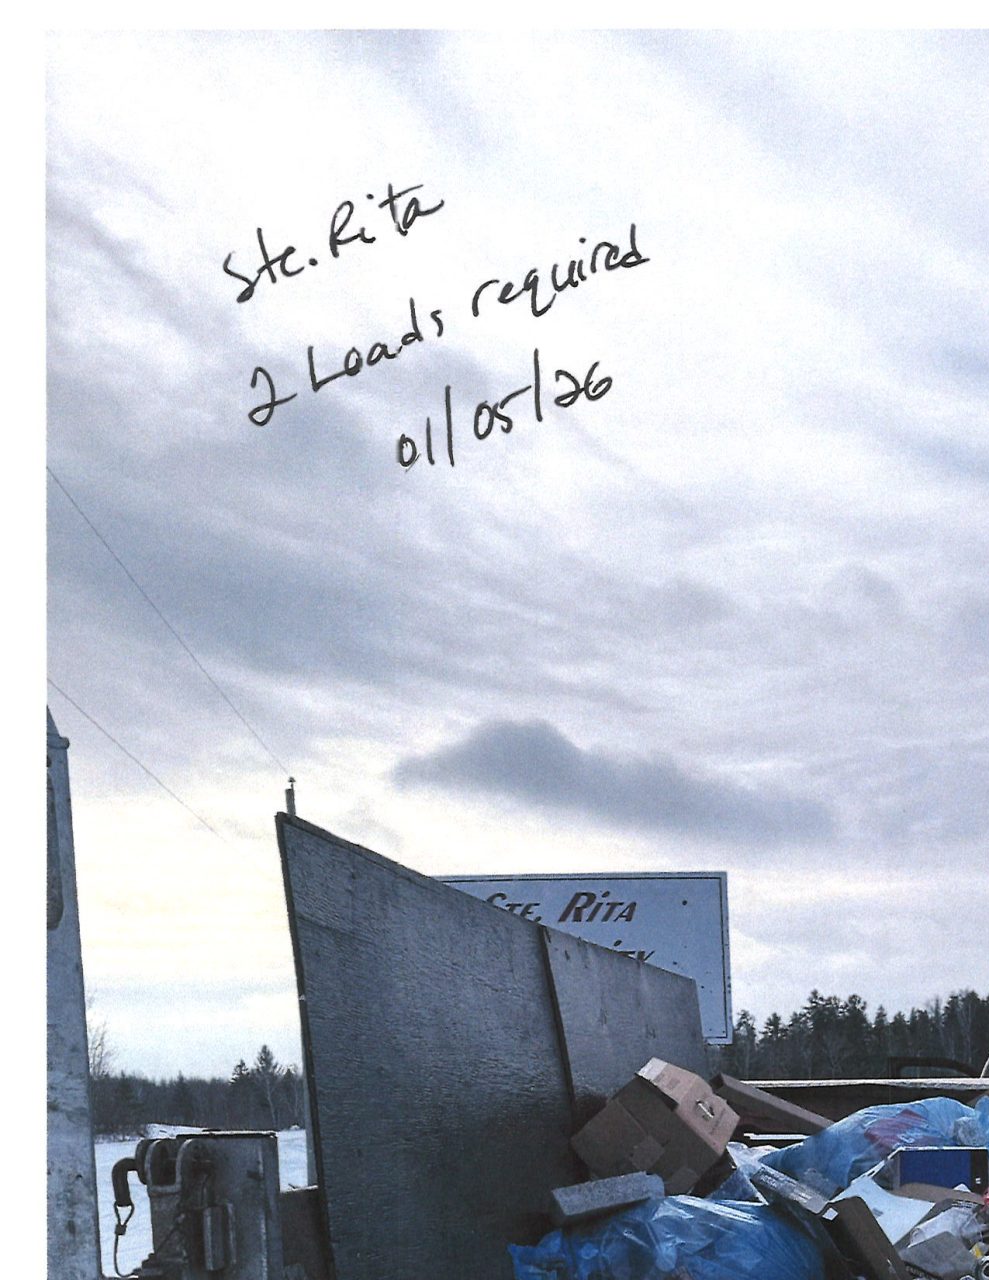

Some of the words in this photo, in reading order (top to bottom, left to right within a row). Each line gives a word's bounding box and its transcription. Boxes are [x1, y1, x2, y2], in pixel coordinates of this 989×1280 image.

[248, 367, 297, 426] 2
[308, 298, 443, 392] Loads
[472, 224, 649, 317] required
[398, 349, 612, 467] 01/05/26
